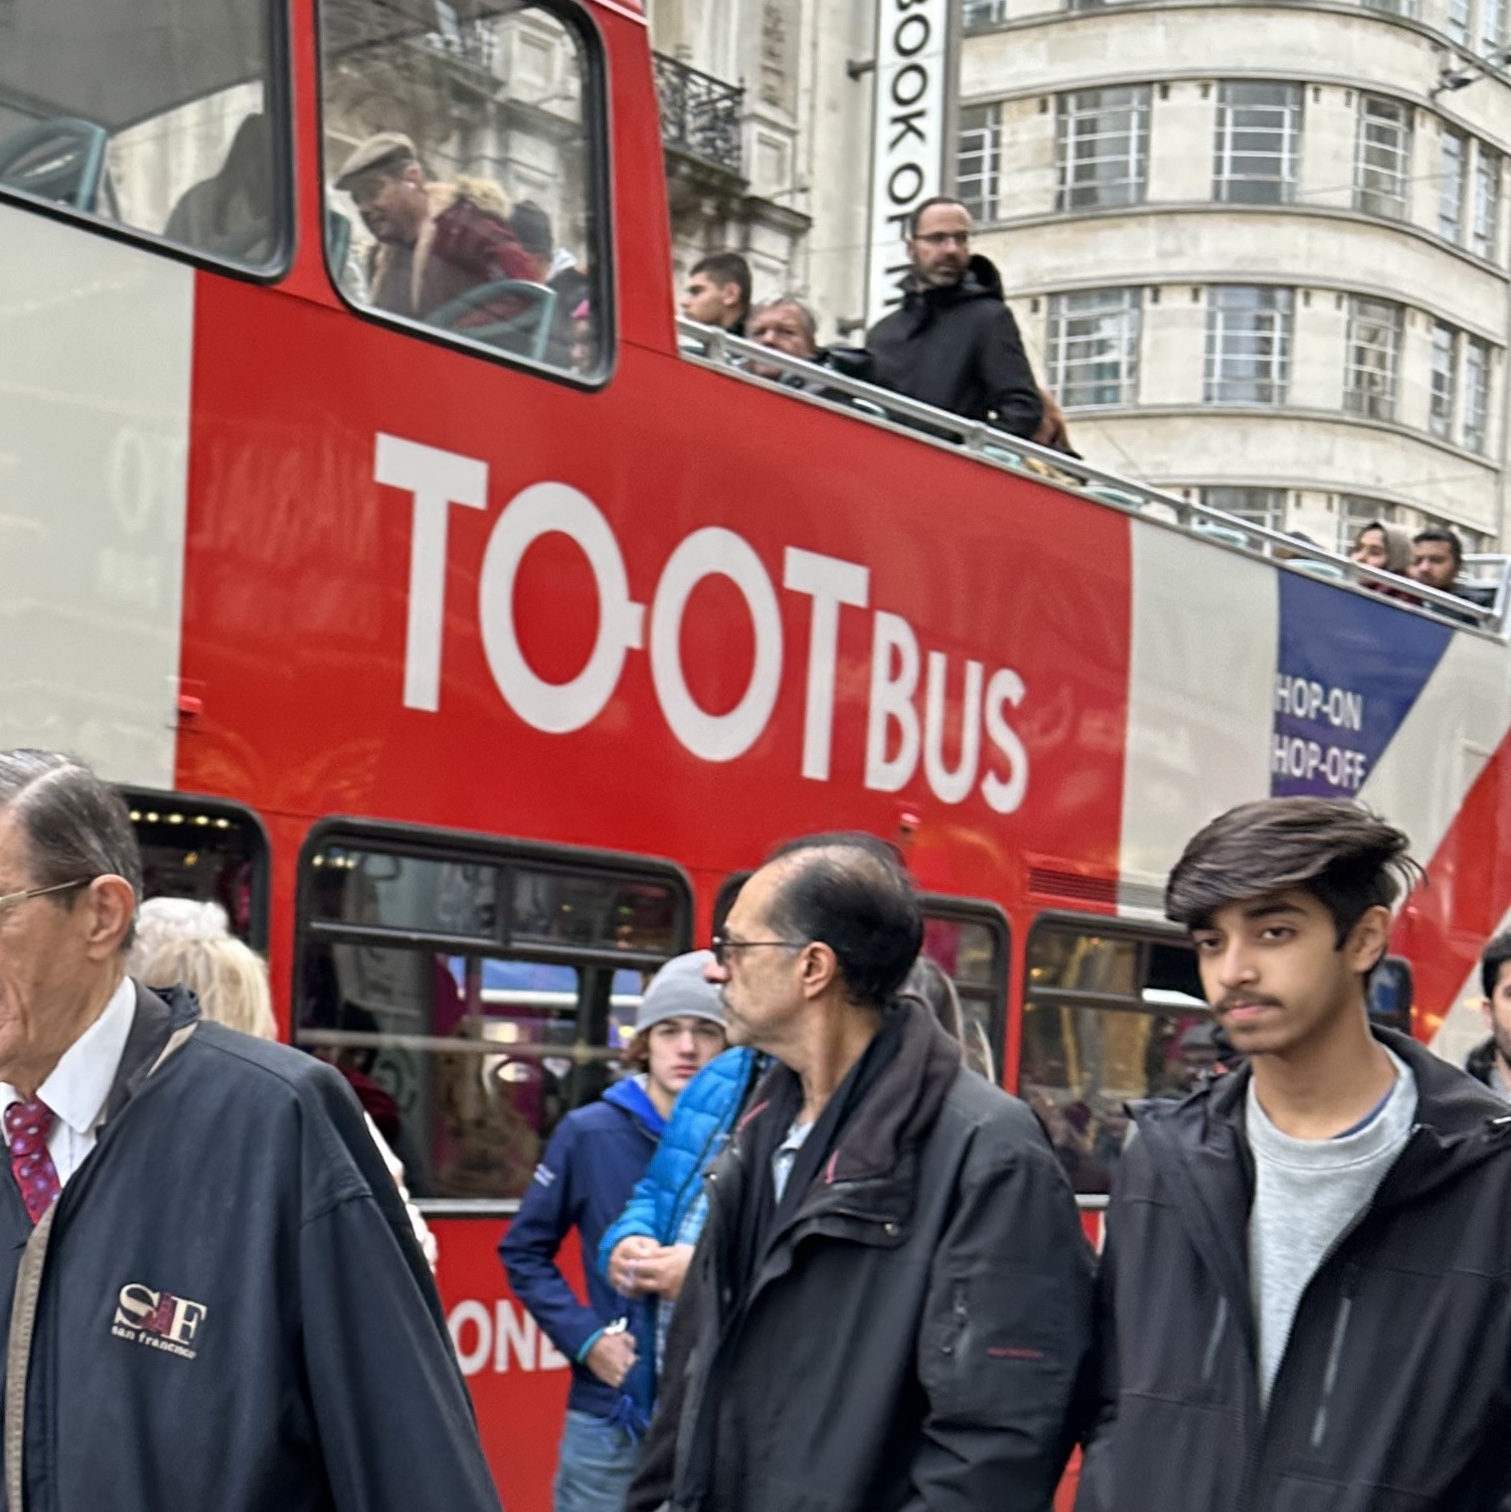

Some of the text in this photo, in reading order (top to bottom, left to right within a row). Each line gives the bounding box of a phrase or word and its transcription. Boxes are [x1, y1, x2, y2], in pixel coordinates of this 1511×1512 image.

[1274, 675, 1363, 731] HOP-ON
[1271, 734, 1367, 789] HOP-OFF
[111, 1325, 136, 1341] san
